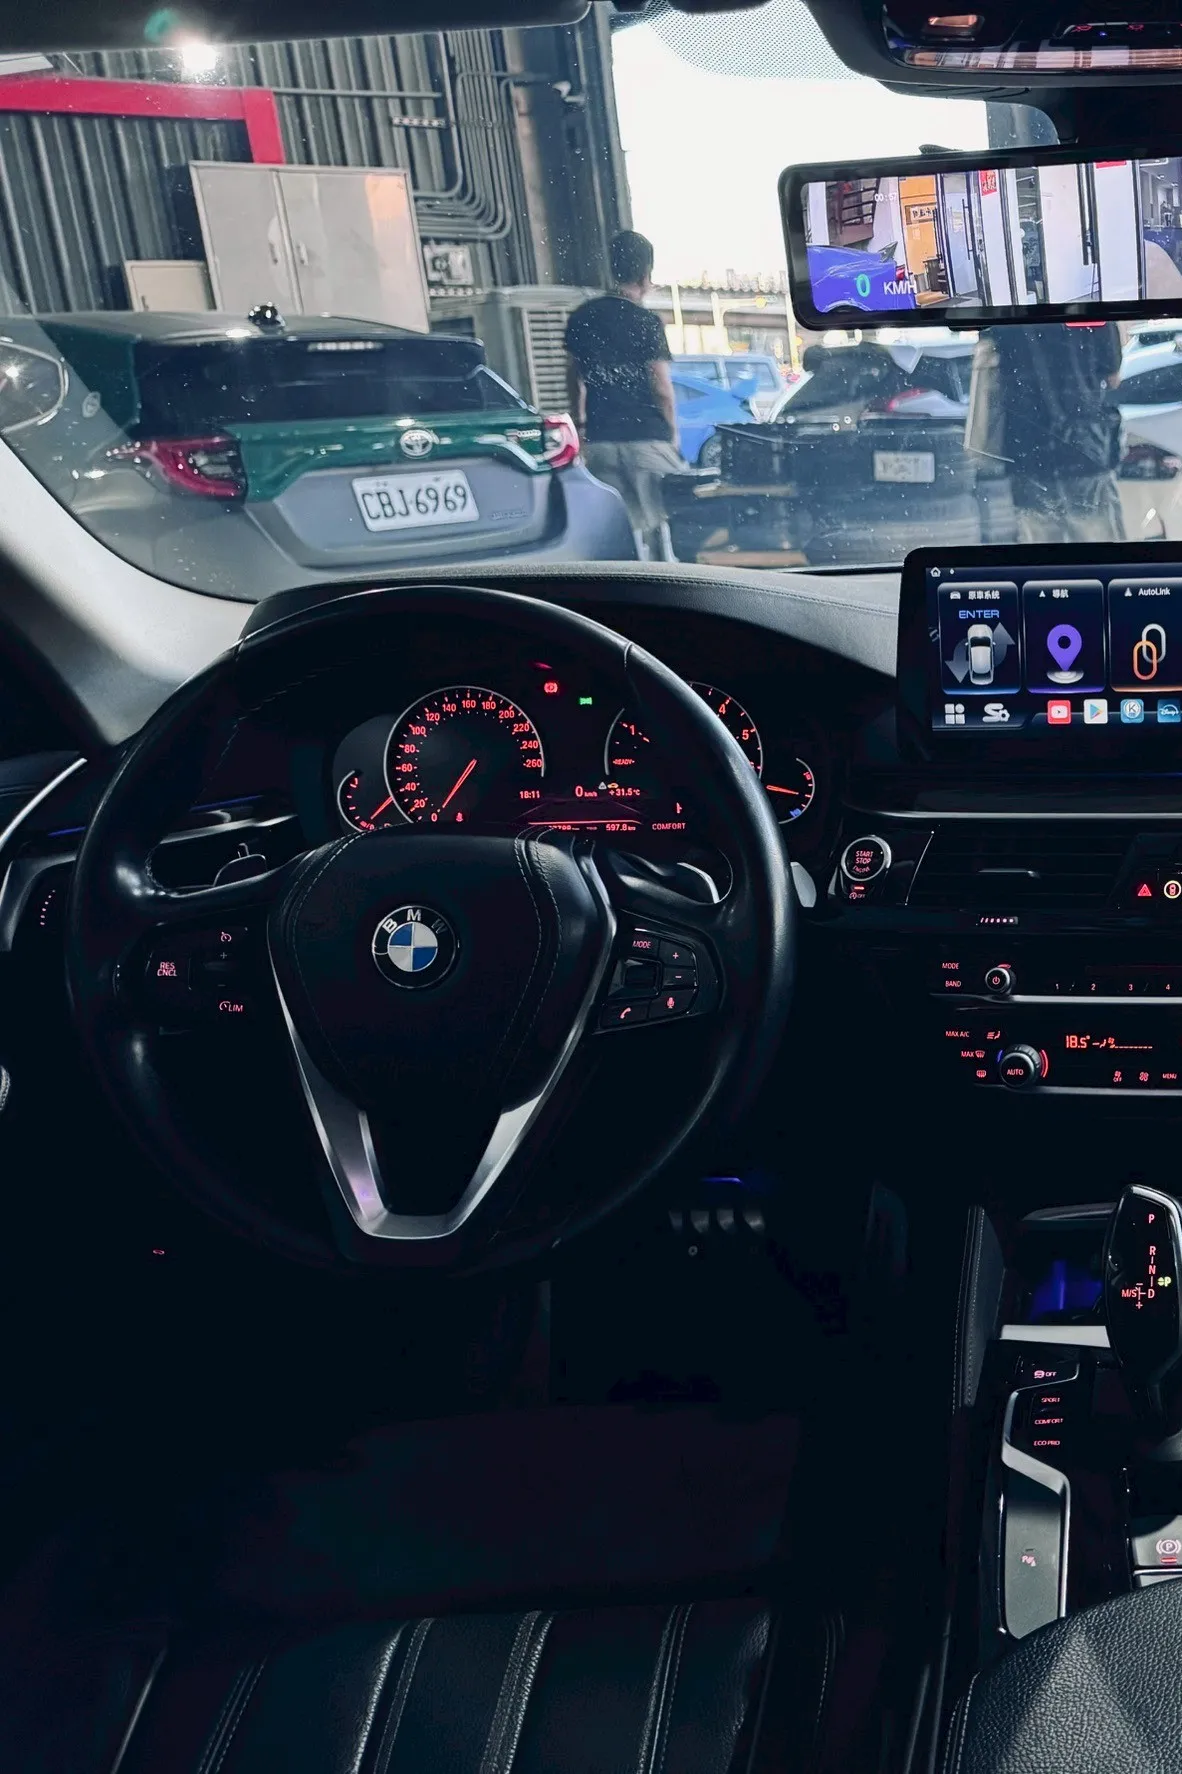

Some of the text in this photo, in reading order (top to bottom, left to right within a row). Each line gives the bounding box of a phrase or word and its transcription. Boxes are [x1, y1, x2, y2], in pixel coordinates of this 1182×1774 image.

[856, 273, 917, 297] 0 KM/H
[1138, 587, 1171, 596] AutoLink
[958, 609, 1000, 619] ENTER
[442, 703, 457, 712] 140
[461, 700, 477, 709] 160
[481, 701, 497, 710] 180
[719, 704, 726, 714] 4
[425, 713, 440, 721] 120
[498, 710, 515, 719] 200
[411, 726, 426, 735] 100
[513, 723, 530, 732] 220
[629, 725, 635, 735] 1
[742, 729, 749, 740] 5
[404, 744, 416, 753] 80
[522, 740, 539, 749] 240
[401, 763, 413, 772] 60
[525, 759, 542, 768] 260
[404, 782, 416, 791] 40
[575, 785, 583, 797] 0
[519, 790, 540, 799] 18:11
[413, 799, 426, 808] 20
[431, 813, 438, 822] 0
[605, 823, 628, 831] 597.8
[632, 940, 652, 949] MODE
[160, 961, 175, 970] RES
[942, 962, 959, 970] MODE
[157, 968, 178, 977] CNCL
[945, 980, 961, 988] BAND
[228, 1004, 244, 1012] LIM
[1148, 1213, 1155, 1224] P
[1149, 1245, 1156, 1256] R
[1148, 1264, 1156, 1275] N
[1121, 1289, 1137, 1298] M/S
[1147, 1288, 1155, 1299] D
